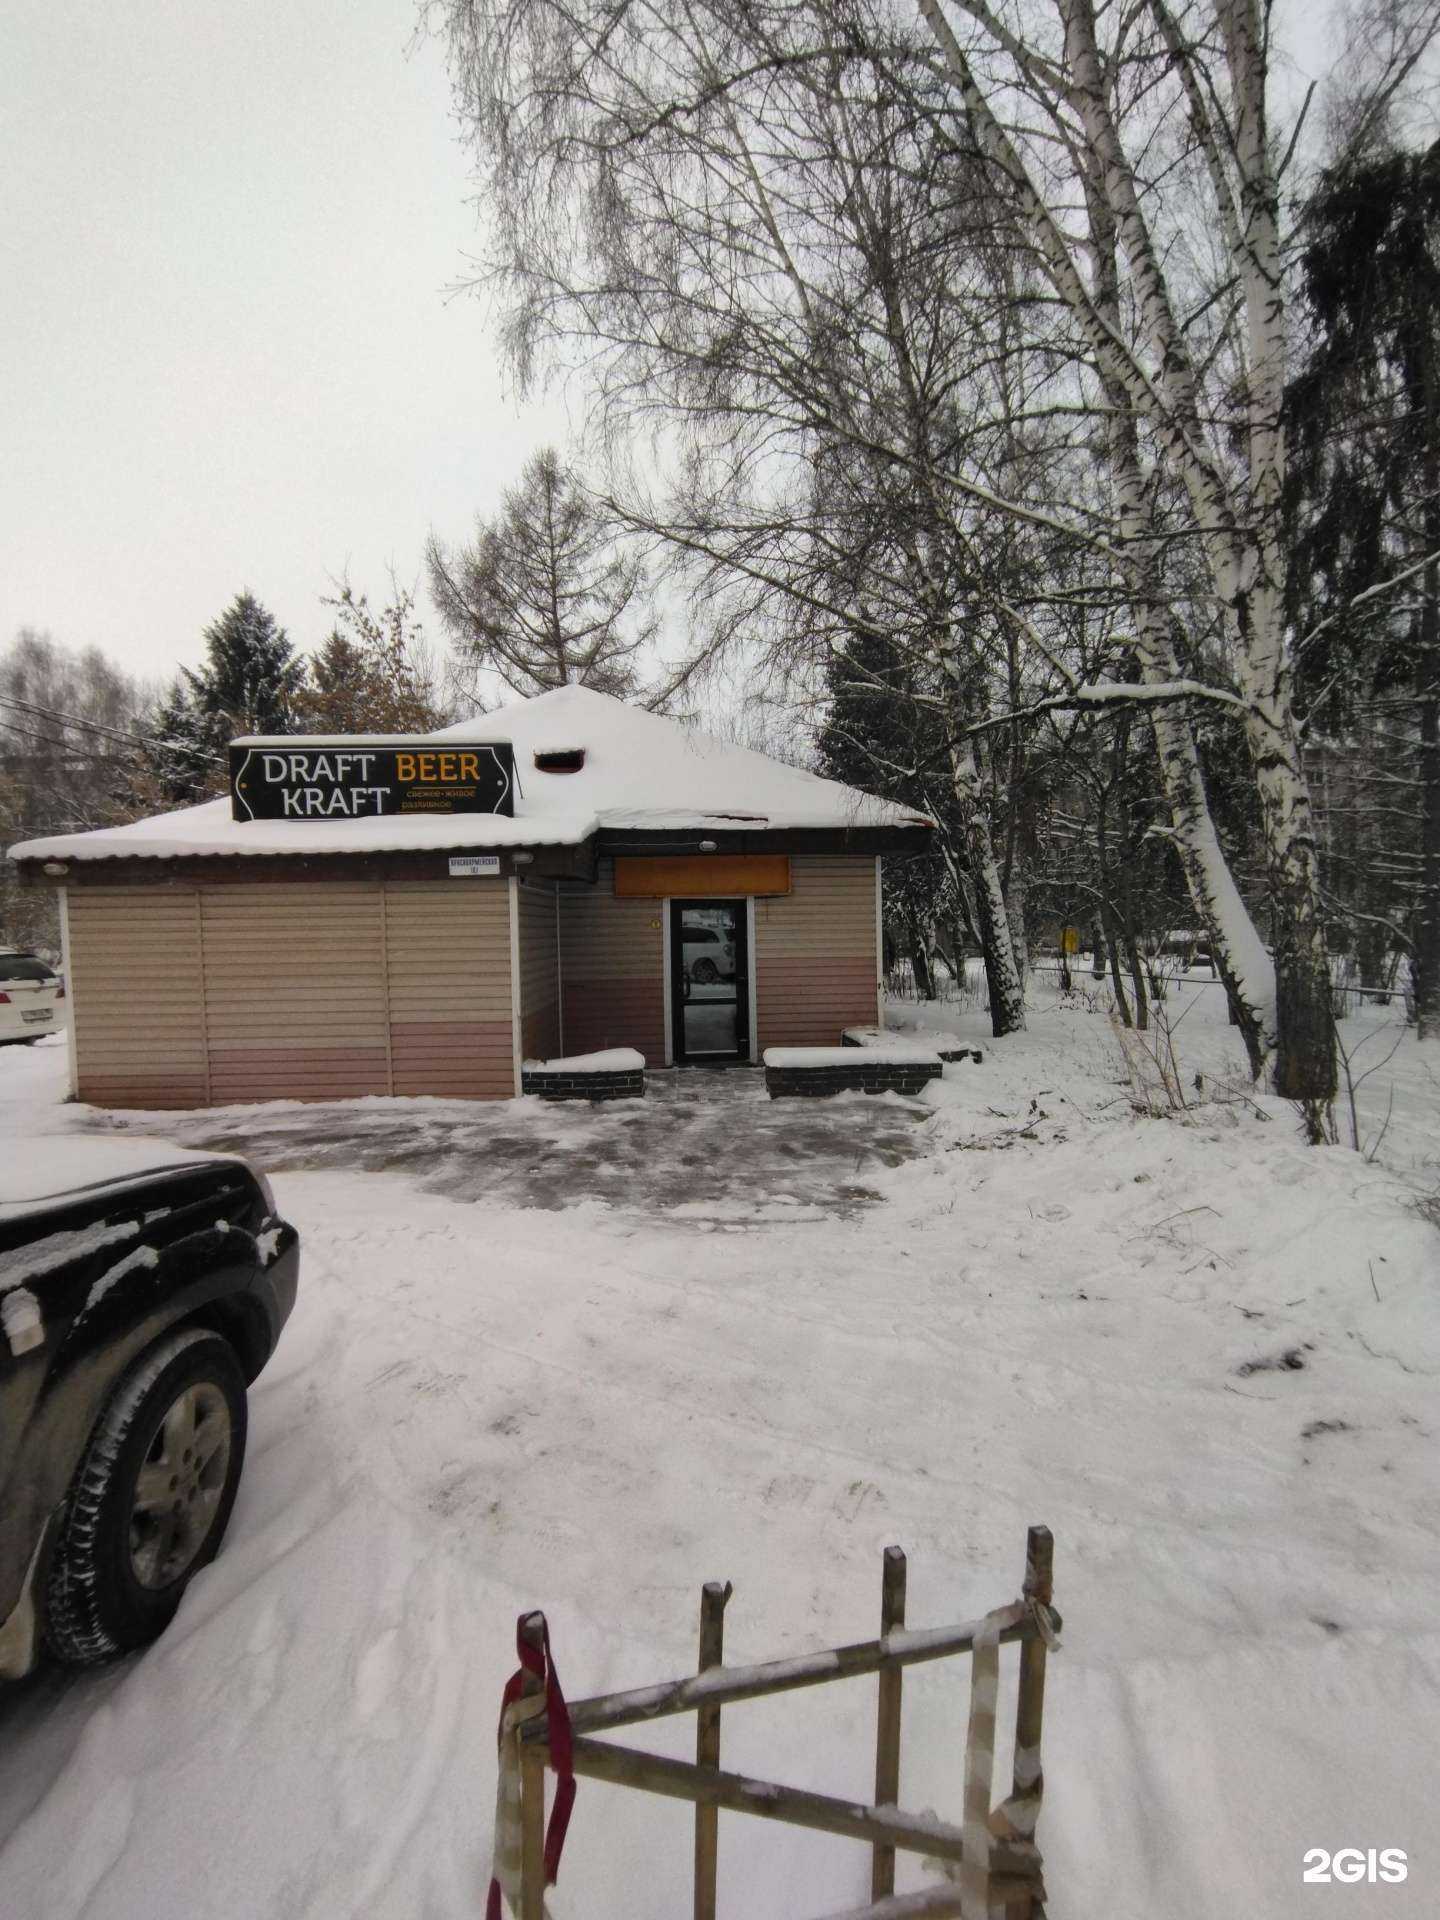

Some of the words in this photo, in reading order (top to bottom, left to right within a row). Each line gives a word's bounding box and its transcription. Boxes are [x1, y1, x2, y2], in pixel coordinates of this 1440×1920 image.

[262, 754, 376, 783] DRAFT
[396, 753, 481, 781] BEER
[281, 787, 391, 816] KRAFT
